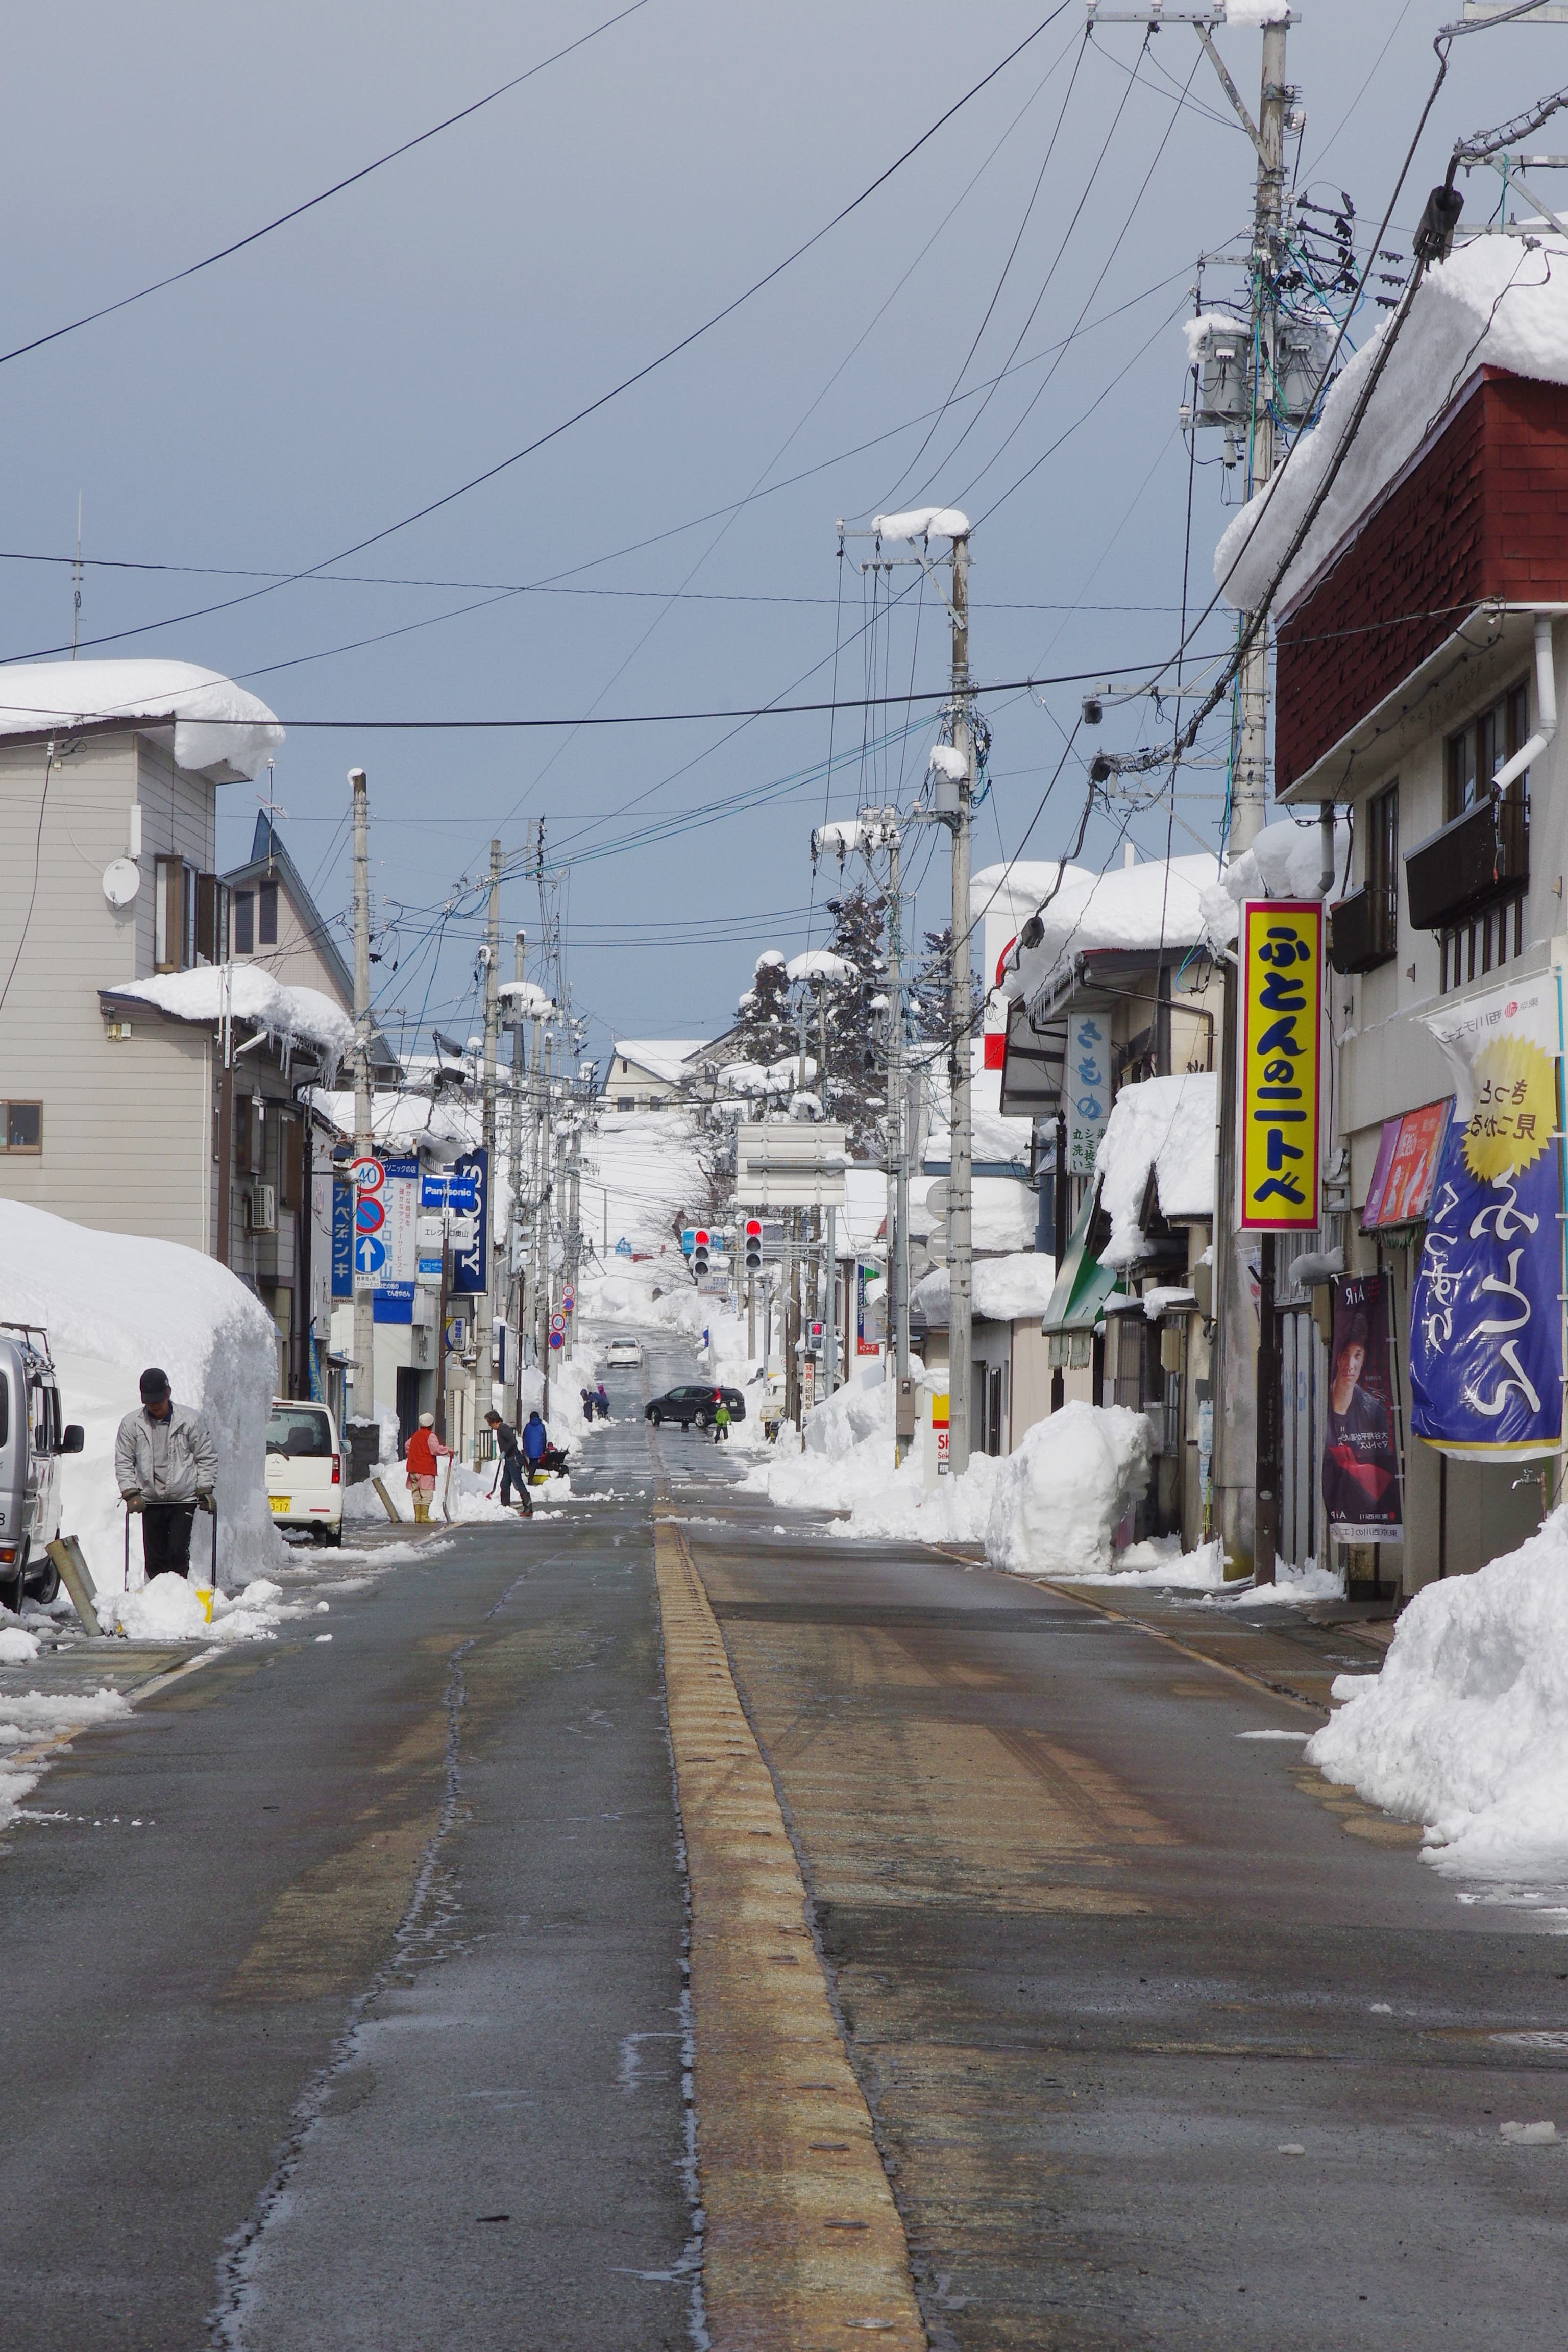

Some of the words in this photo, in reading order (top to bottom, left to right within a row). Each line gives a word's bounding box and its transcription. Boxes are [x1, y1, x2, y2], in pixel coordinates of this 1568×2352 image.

[1077, 1018, 1102, 1121] きもの
[1253, 927, 1310, 1205] ふとんのニトベ
[1072, 1128, 1083, 1170] 丸洗い
[359, 1167, 377, 1184] 40
[425, 1186, 472, 1197] Pansonic
[335, 1187, 351, 1278] アベデンキ
[424, 1228, 469, 1238] エレクロ奥山
[554, 1318, 563, 1327] 40
